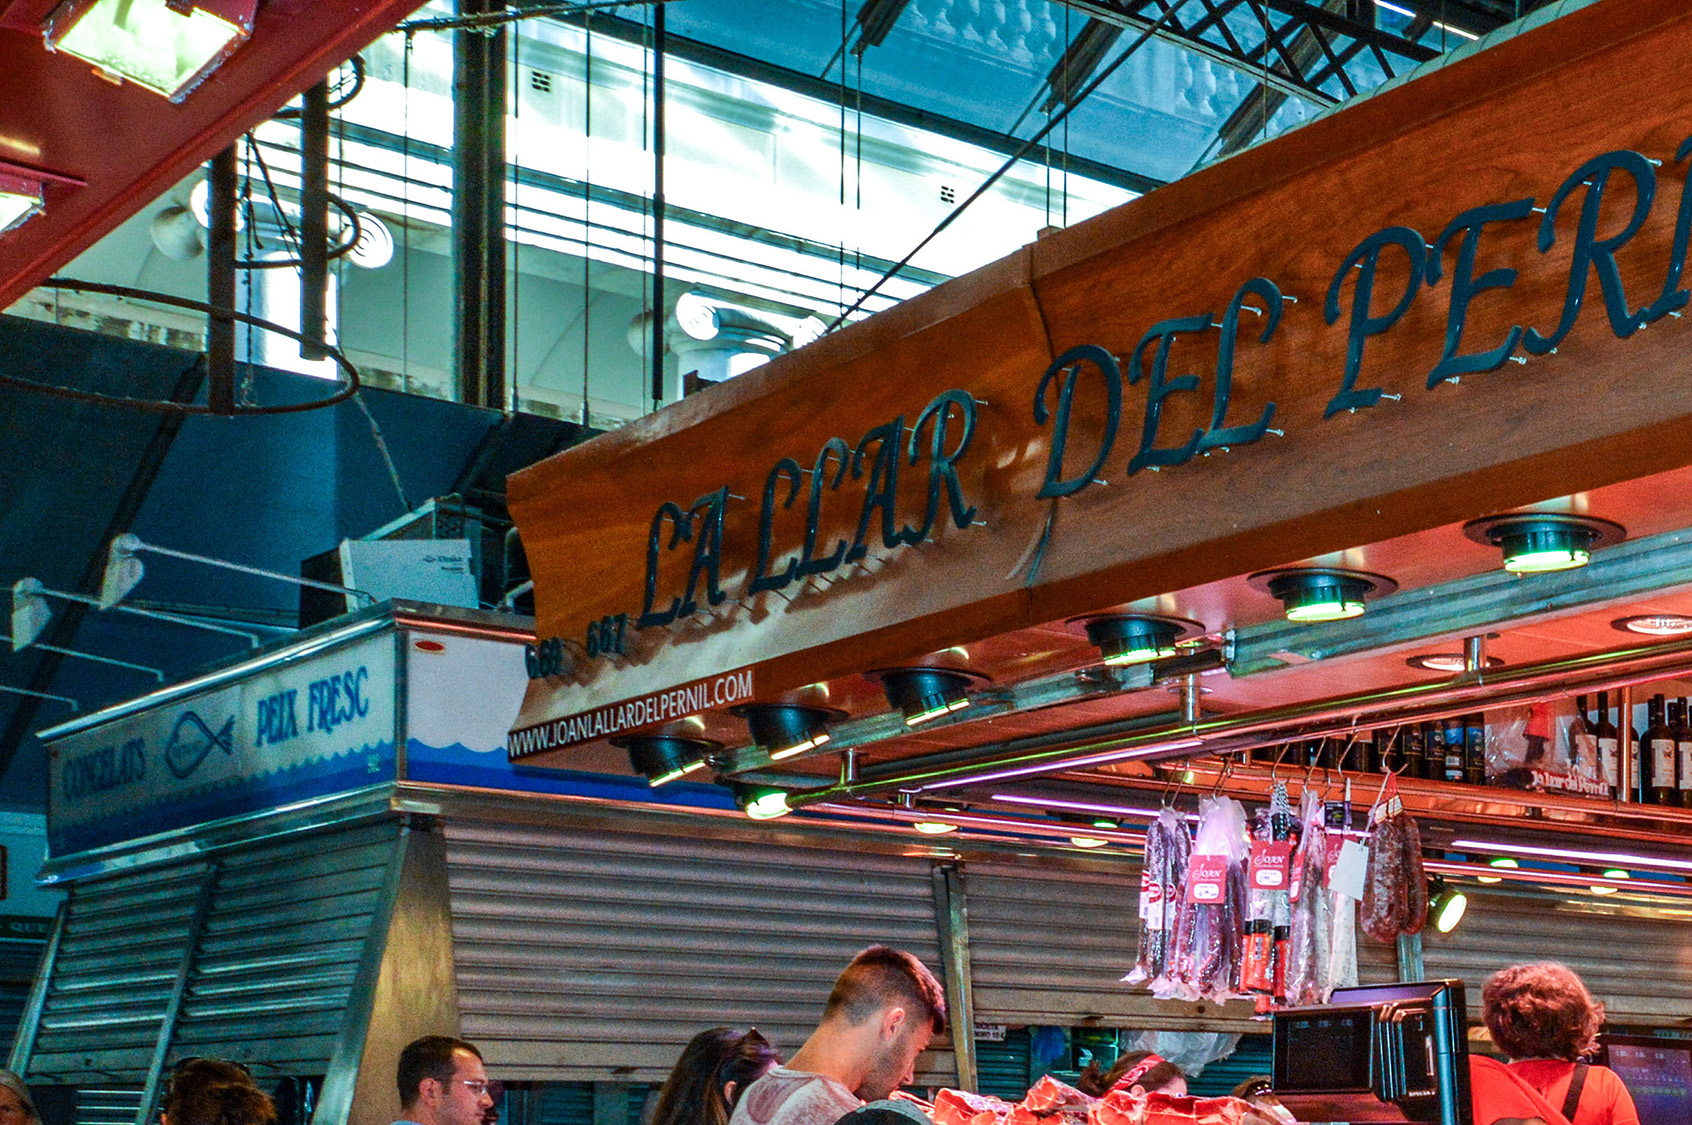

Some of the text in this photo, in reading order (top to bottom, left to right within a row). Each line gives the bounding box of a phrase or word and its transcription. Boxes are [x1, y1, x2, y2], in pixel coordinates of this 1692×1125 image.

[634, 484, 731, 628] LA
[748, 388, 978, 596] LLAR
[1033, 277, 1283, 500] DEL
[586, 612, 629, 659] 667
[255, 665, 370, 748] PEIX FRESC
[509, 670, 753, 757] WWW.JOANLALLARDELPERNIL.COM
